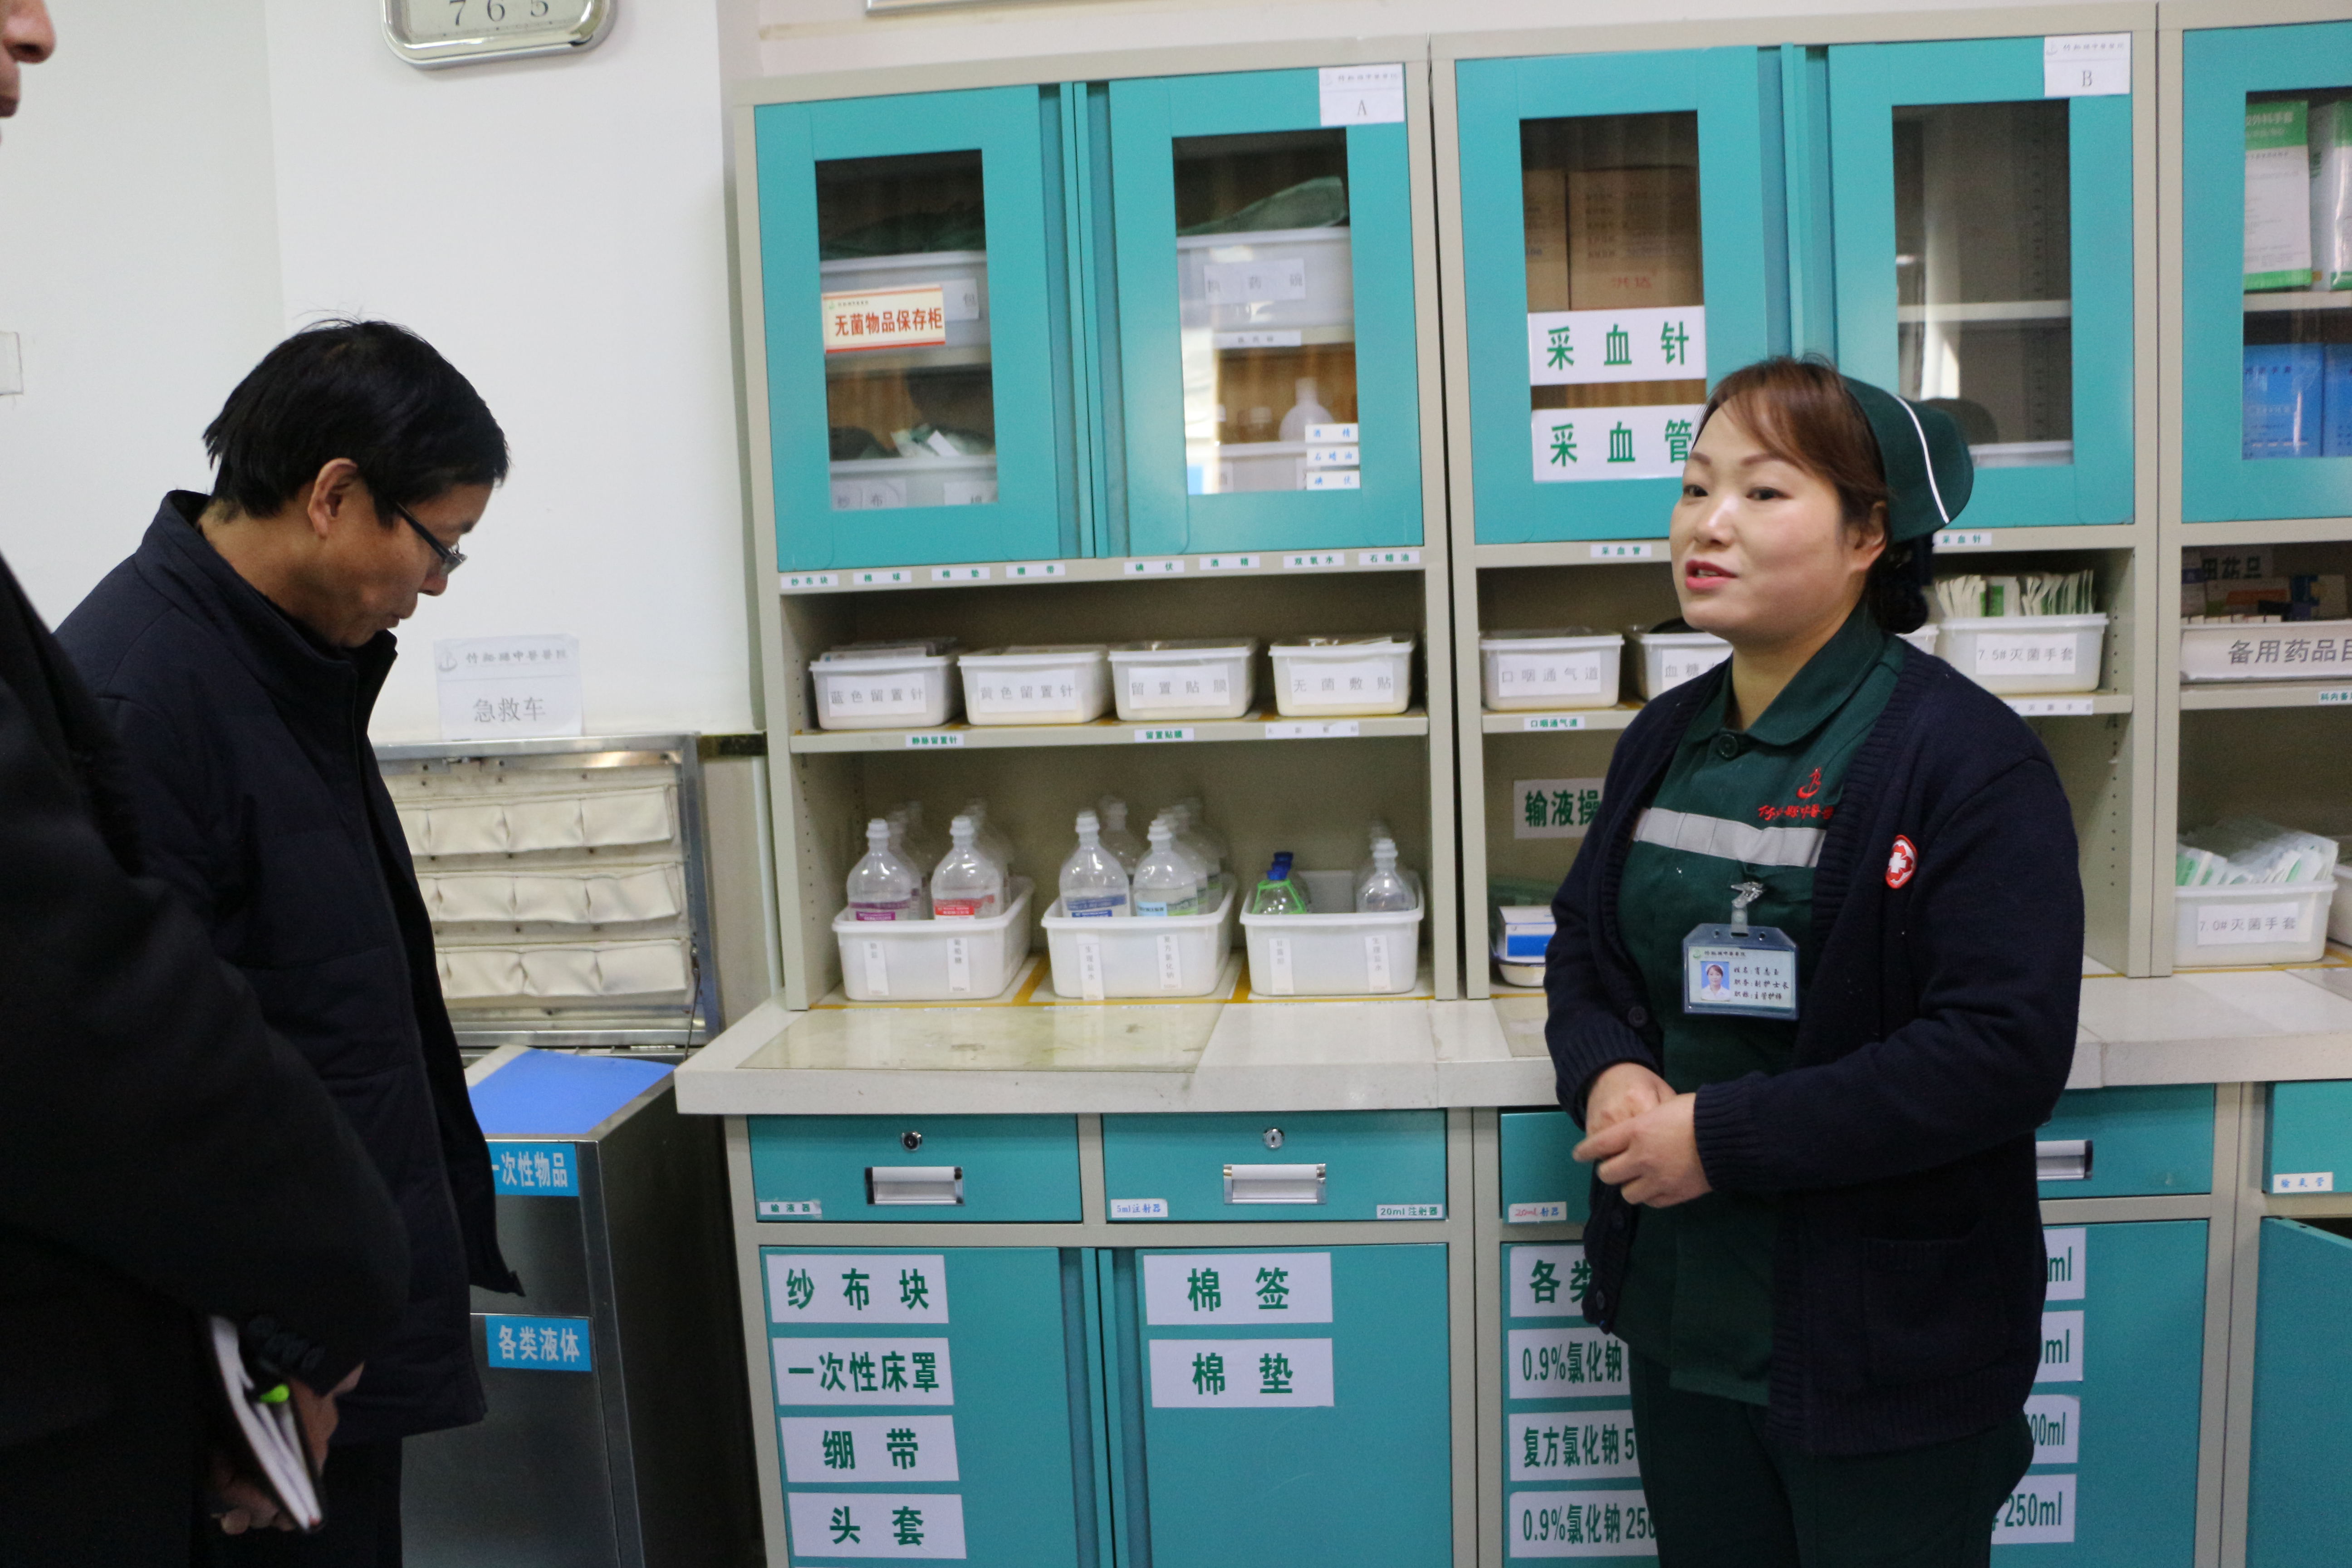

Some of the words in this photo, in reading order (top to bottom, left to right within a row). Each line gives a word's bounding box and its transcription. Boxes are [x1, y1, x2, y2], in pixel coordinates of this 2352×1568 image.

[449, 0, 466, 25] 7
[487, 0, 505, 21] 6
[531, 0, 548, 17] 5
[2082, 70, 2092, 87] B
[1357, 99, 1367, 116] A
[835, 307, 943, 336] 无菌物品保存柜
[1547, 320, 1690, 370] 采血针
[1313, 428, 1351, 438] 酒精
[1550, 419, 1692, 467] 采血管
[1210, 557, 1249, 567] 酒精
[1294, 555, 1334, 566] 双氧水
[1370, 553, 1410, 563] 石蜡油
[1131, 677, 1228, 696] 留置贴膜
[1293, 675, 1392, 694] 无菌敷贴
[1501, 666, 1599, 683] 口咽通气道
[830, 686, 924, 706] 蓝色留置针
[980, 683, 1074, 701] 黄色留置针
[2320, 691, 2352, 701] 科内备
[473, 696, 546, 723] 急救车
[1530, 718, 1578, 728] 口咽通气道
[911, 735, 958, 745] 静脉留置针
[1146, 729, 1183, 740] 留置贴膜
[1524, 789, 1602, 827] 输液操
[771, 1203, 810, 1212] 输液器
[1380, 1207, 1405, 1215] 20ml
[1408, 1206, 1438, 1216] 注射器
[2048, 1246, 2072, 1282] ml
[786, 1268, 929, 1311] 纱布块
[1187, 1267, 1289, 1312] 棉签
[1529, 1259, 1593, 1303] 各类
[499, 1324, 581, 1362] 各类液体
[2045, 1328, 2070, 1364] ml
[788, 1350, 940, 1393] 一次性床罩
[1192, 1352, 1293, 1395] 棉垫
[1523, 1340, 1622, 1383] 0.9%氯化钠
[2026, 1411, 2066, 1446] 00ml
[822, 1428, 919, 1470] 绷带
[1524, 1424, 1620, 1468] 复方氯化钠
[2004, 1491, 2063, 1527] 250ml
[829, 1506, 925, 1546] 头套
[1523, 1503, 1621, 1544] 0.9%氯化钠
